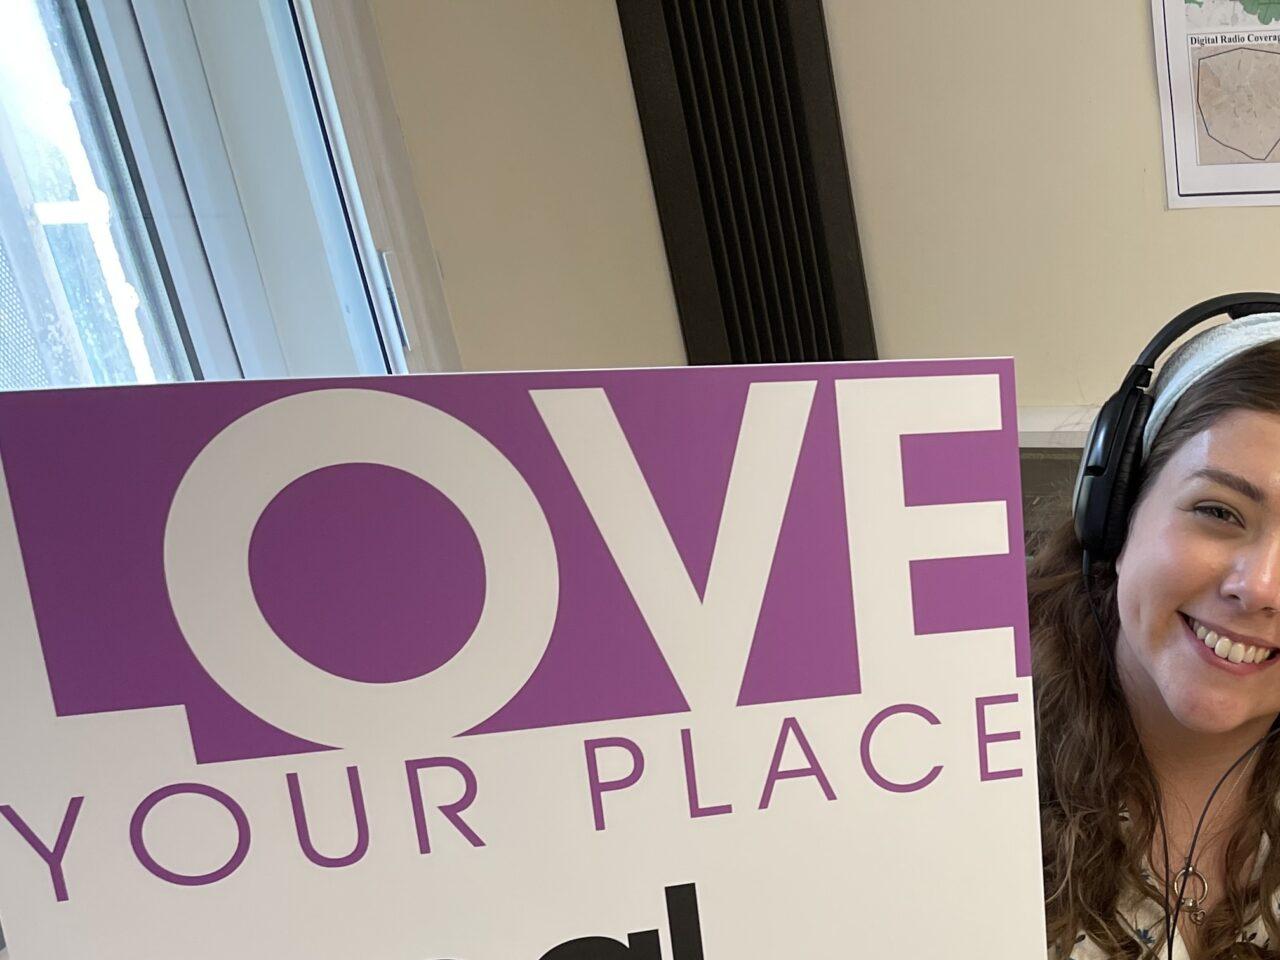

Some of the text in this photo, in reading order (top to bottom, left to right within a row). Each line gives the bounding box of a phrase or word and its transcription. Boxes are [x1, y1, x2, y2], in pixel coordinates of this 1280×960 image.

[1190, 35, 1218, 46] Digital
[1220, 34, 1245, 44] Radio
[0, 373, 1018, 766] LOVE
[0, 692, 1025, 903] YOUR PLACE
